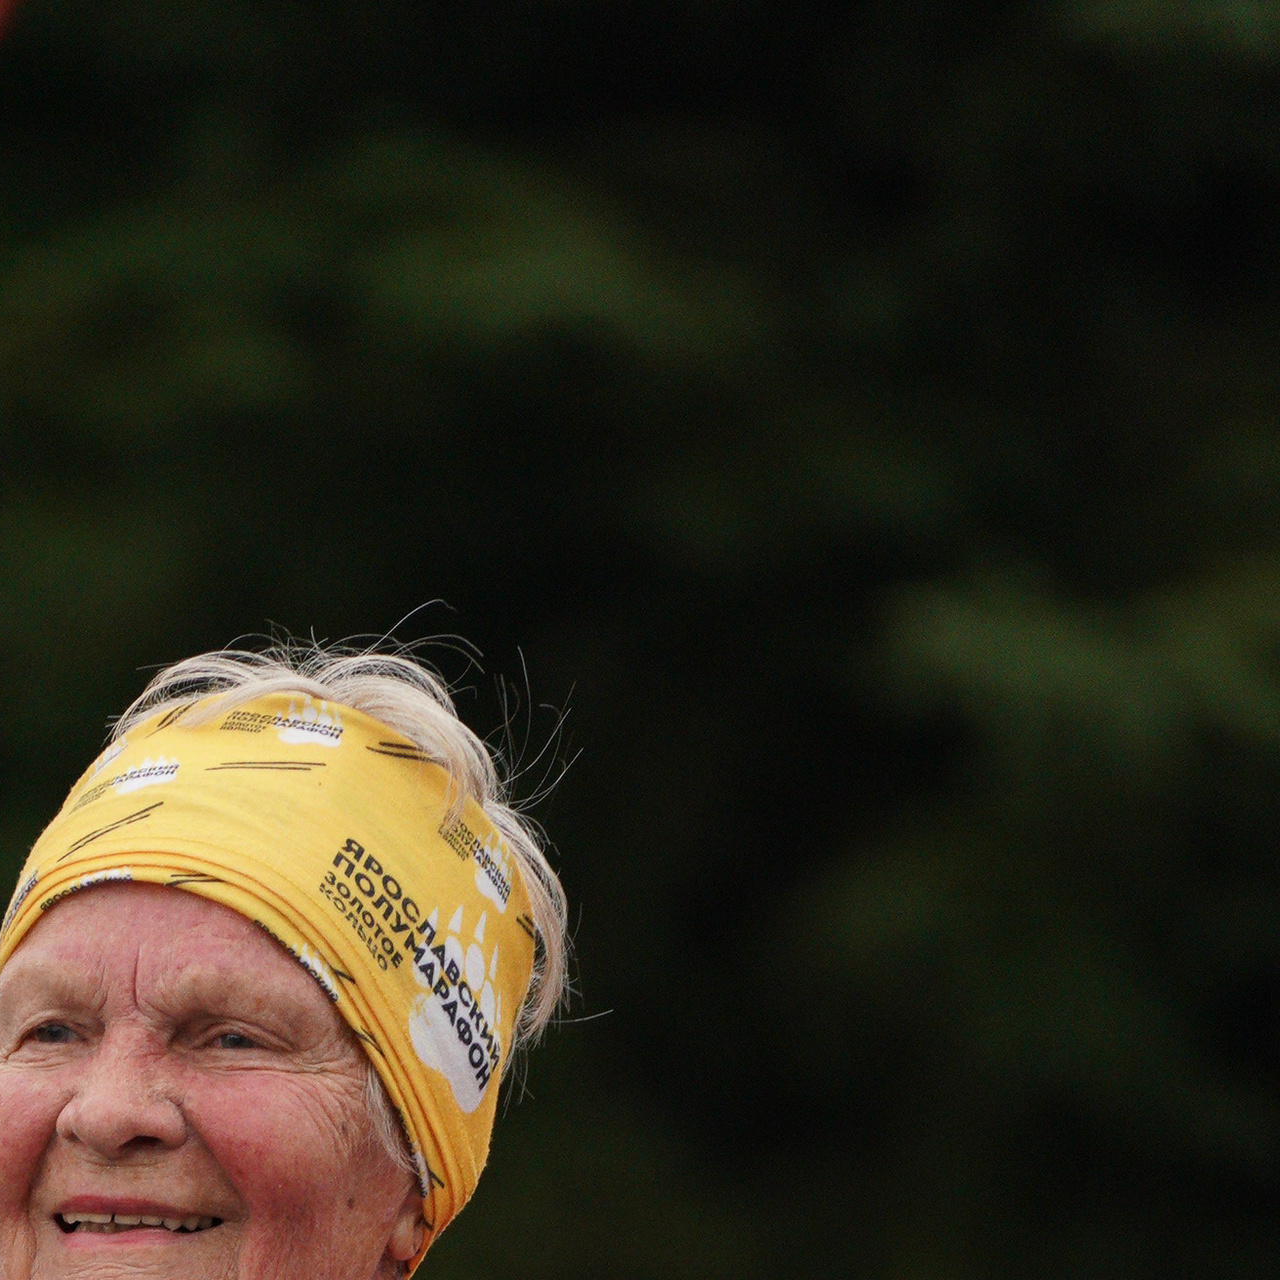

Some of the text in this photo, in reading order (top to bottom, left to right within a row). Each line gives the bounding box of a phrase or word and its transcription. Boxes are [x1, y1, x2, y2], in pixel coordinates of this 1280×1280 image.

[319, 882, 388, 971] КОЛЬЦО
[324, 870, 404, 969] ЗОЛОТОЕ
[332, 850, 491, 1091] ПОЛУМАРАФОН
[341, 838, 501, 1073] ЯРОСЛАВСКИЙ
